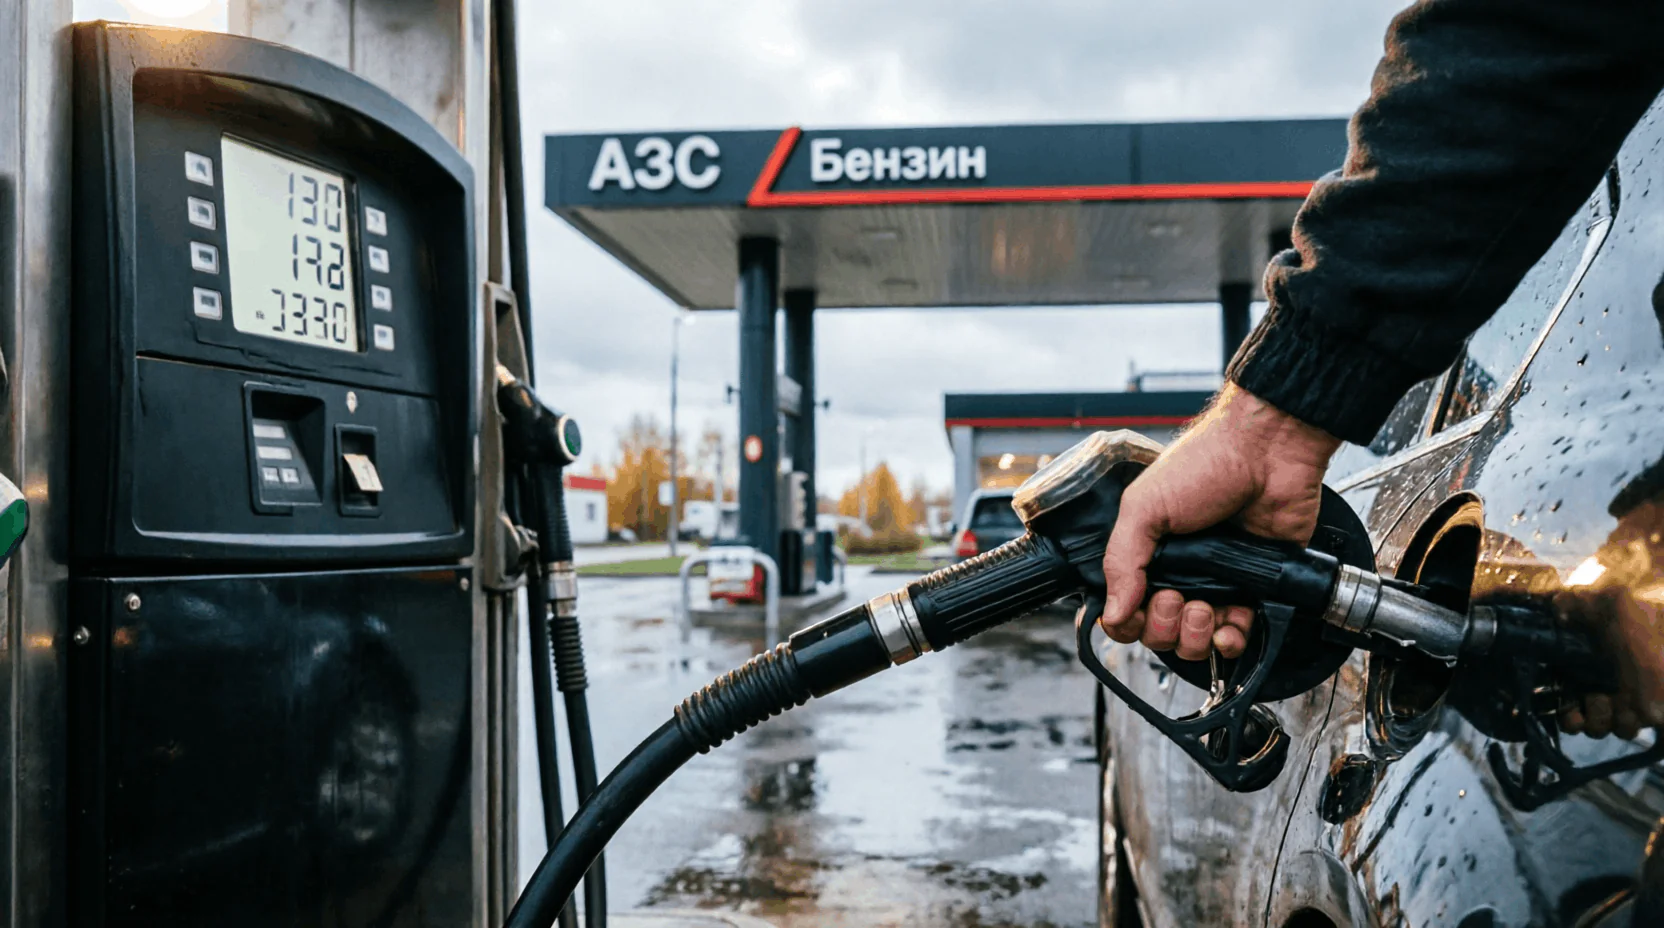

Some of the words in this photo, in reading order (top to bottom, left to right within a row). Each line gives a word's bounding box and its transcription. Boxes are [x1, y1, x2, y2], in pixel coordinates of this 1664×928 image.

[588, 135, 721, 191] АЗС
[810, 138, 987, 182] Бензин
[288, 172, 342, 233] 130
